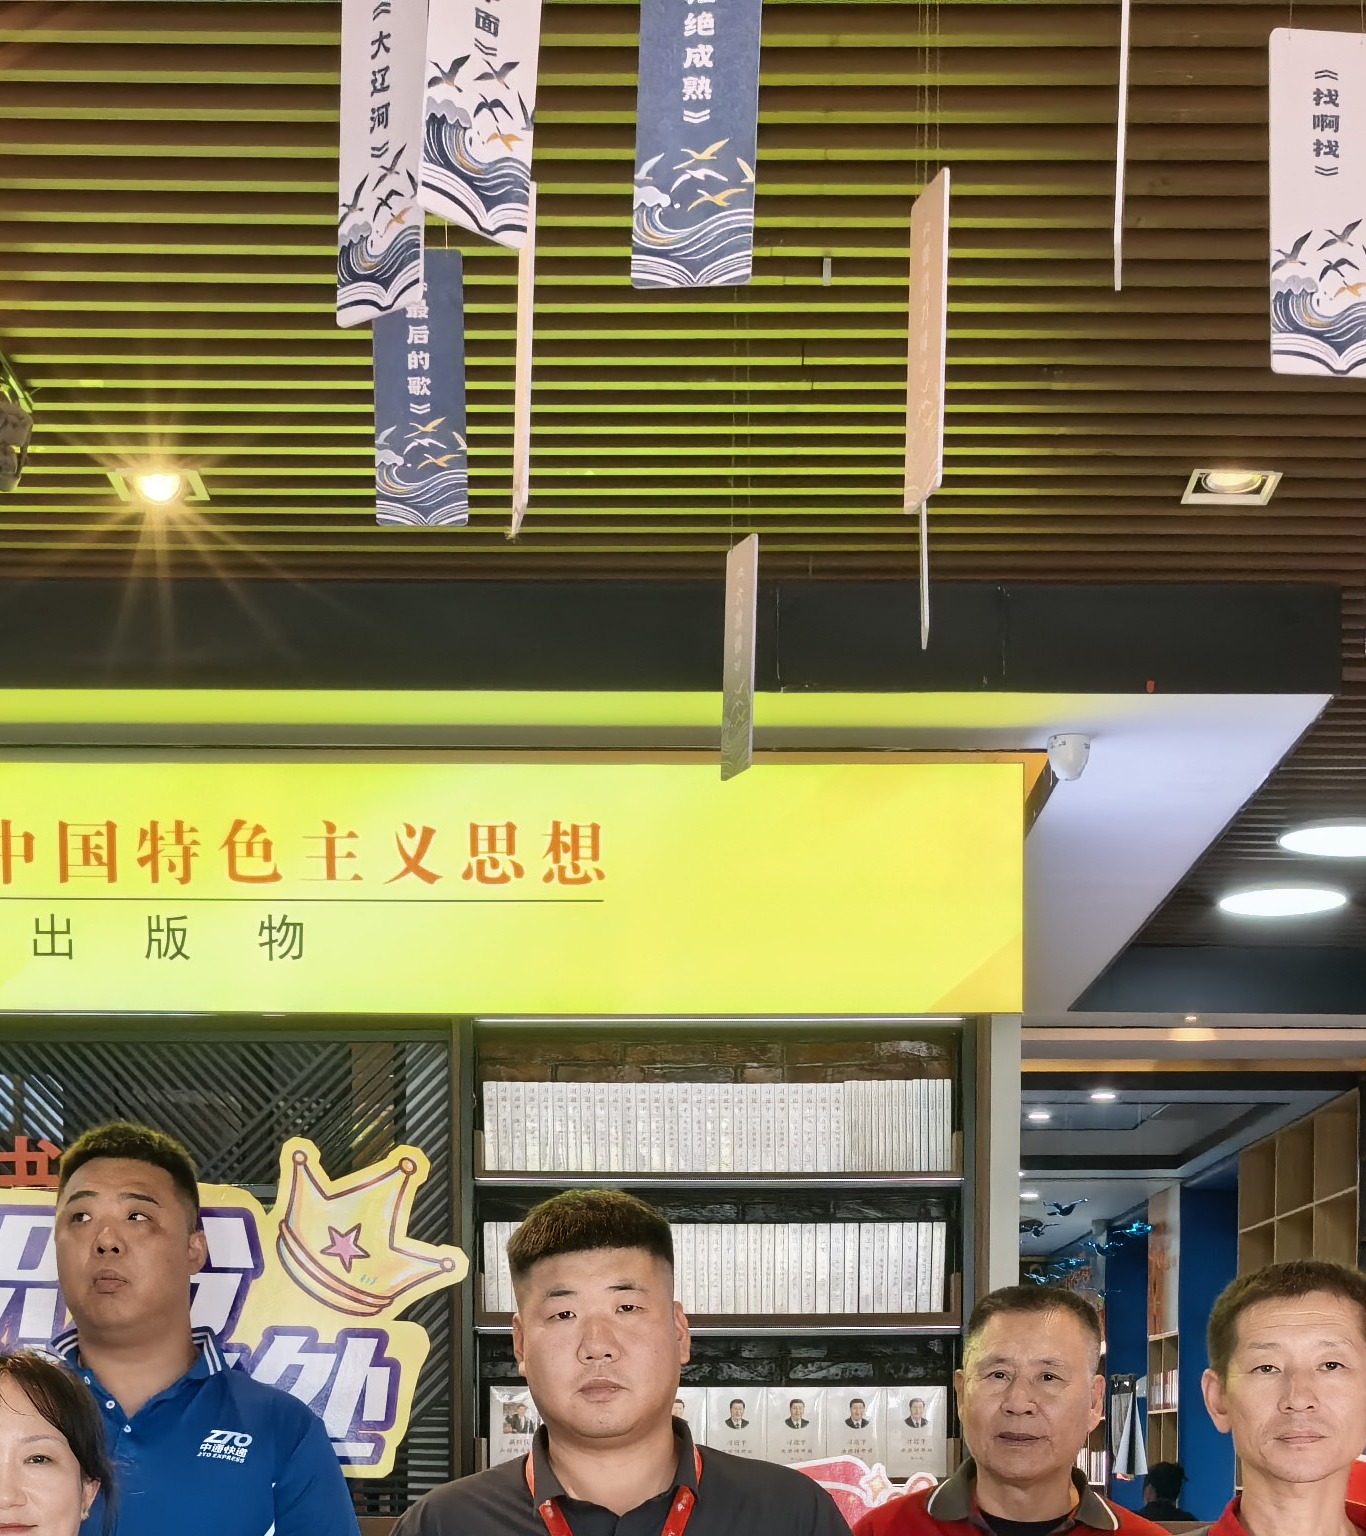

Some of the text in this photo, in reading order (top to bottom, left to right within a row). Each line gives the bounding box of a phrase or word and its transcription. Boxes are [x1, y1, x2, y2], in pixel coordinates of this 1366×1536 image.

[473, 0, 500, 58] 面》
[682, 0, 715, 124] 绝成熟》
[370, 2, 392, 159] 《大辽河》
[1312, 68, 1340, 178] 《找啊找》
[200, 1443, 248, 1458] 中通快递
[202, 1429, 253, 1447] ZTO
